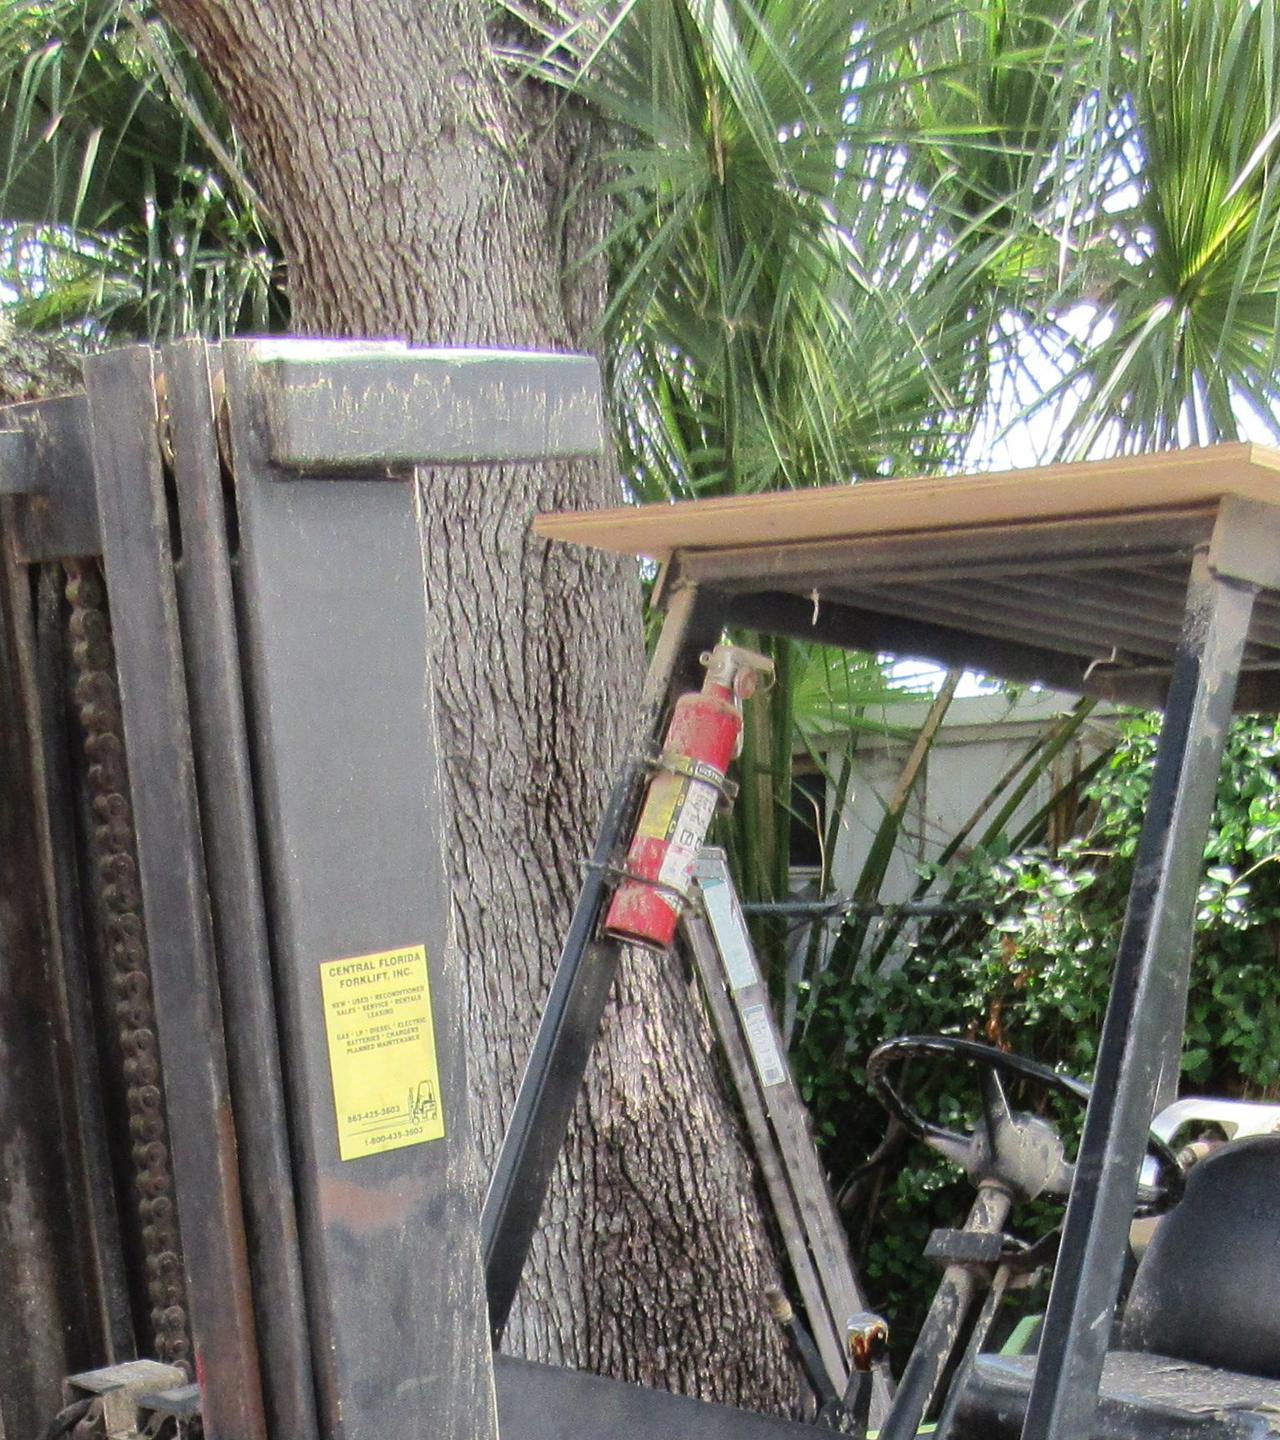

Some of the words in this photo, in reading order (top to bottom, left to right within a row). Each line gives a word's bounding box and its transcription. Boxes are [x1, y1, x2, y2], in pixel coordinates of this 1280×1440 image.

[329, 963, 375, 977] CENTRAL
[379, 953, 421, 968] FLORIDA
[340, 972, 391, 988] FORKLIFT,
[393, 967, 414, 979] INC.
